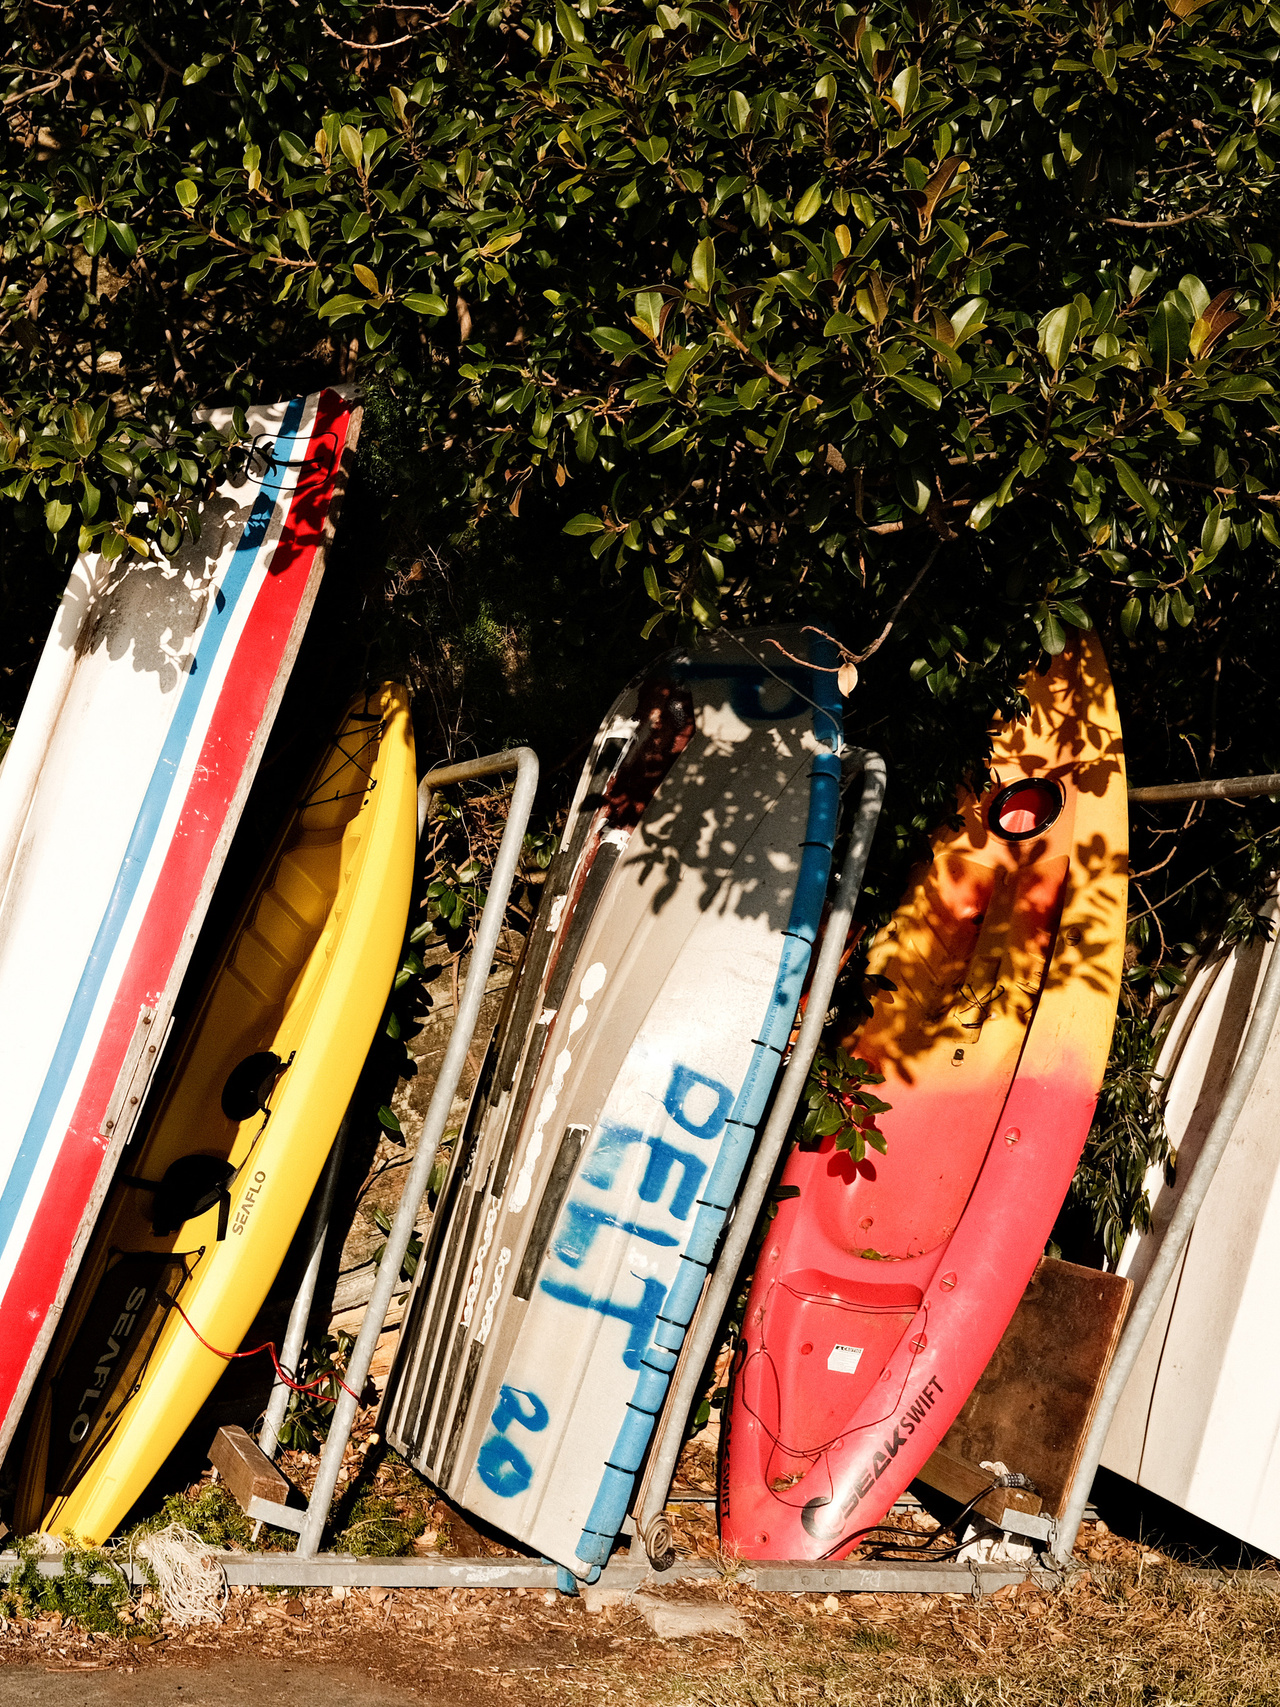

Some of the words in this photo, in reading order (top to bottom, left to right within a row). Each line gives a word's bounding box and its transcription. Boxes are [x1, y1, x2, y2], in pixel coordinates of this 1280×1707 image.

[231, 1170, 266, 1236] SEAFLO
[69, 1287, 147, 1444] SEAFLO
[899, 1375, 945, 1434] SWIFT
